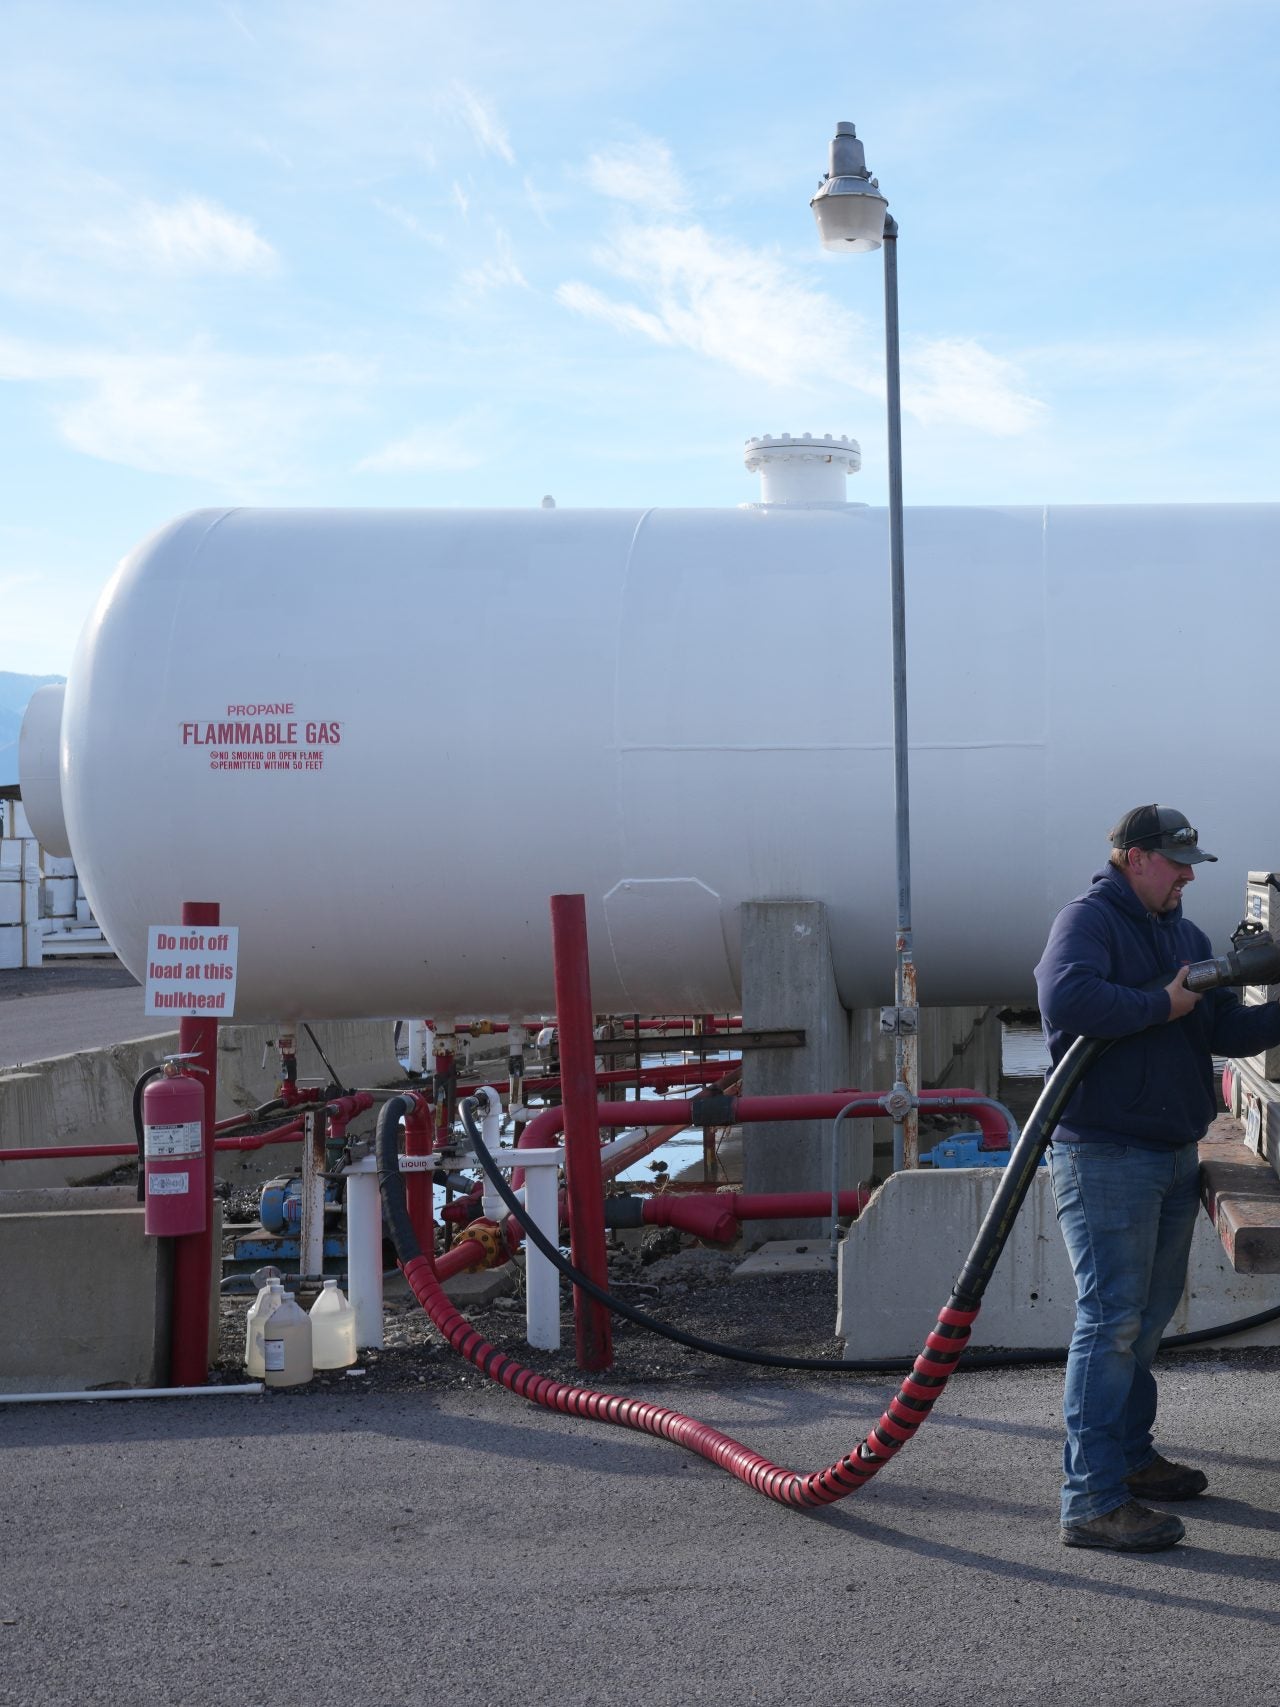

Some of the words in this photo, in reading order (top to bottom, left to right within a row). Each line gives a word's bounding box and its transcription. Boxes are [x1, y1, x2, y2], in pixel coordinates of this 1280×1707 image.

[227, 703, 294, 716] PROPANE
[183, 723, 297, 745] FLAMMABLE
[305, 722, 341, 744] GAS
[219, 751, 229, 760] NO
[232, 751, 264, 760] SMOKING
[267, 751, 276, 760] OR
[280, 751, 297, 760] OPEN
[300, 751, 324, 760] FLAME
[219, 761, 261, 770] PERMITTED
[264, 761, 290, 770] WITHIN
[293, 761, 303, 770] 50
[305, 761, 324, 770] FEET
[157, 933, 177, 951] Do
[179, 935, 205, 951] not
[207, 934, 229, 951] off
[149, 962, 183, 979] load
[185, 964, 201, 980] at
[204, 963, 233, 980] this
[154, 991, 226, 1009] bulkhead
